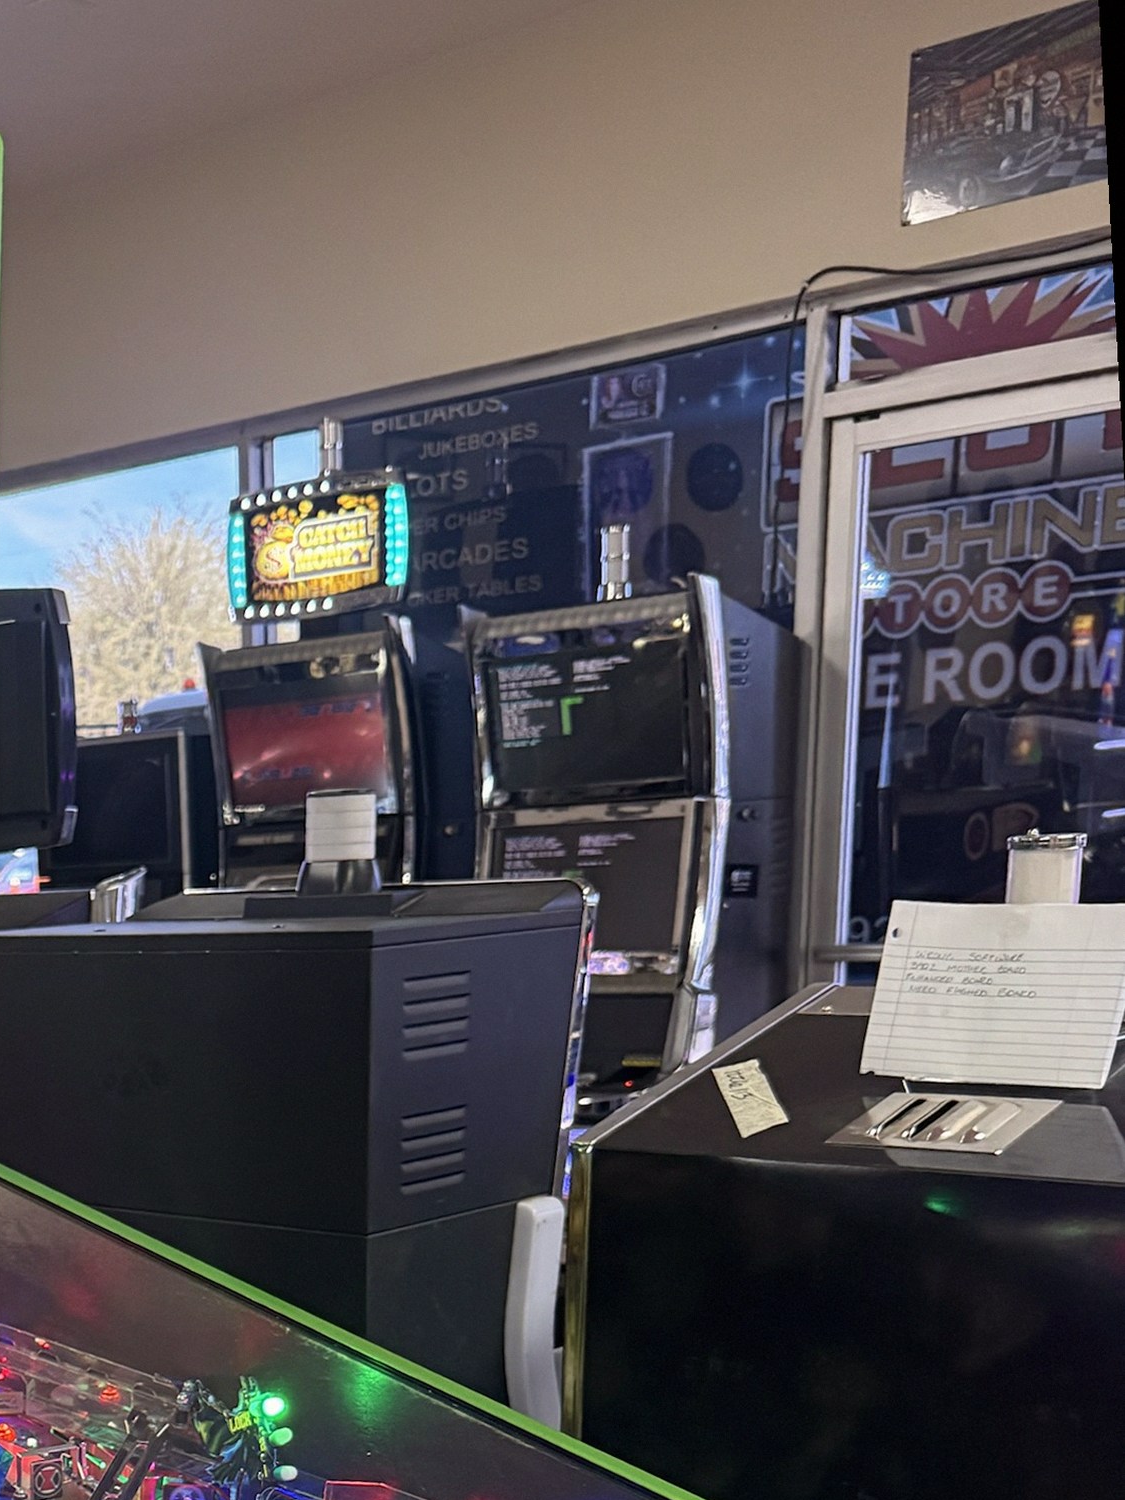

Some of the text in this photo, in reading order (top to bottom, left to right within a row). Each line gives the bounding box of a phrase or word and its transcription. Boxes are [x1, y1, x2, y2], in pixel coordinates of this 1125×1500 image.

[371, 397, 502, 435] BILLIARDS
[419, 421, 539, 460] JUKEBOXES
[298, 518, 368, 548] CATCH
[444, 505, 507, 531] CHIPS
[293, 540, 373, 574] MONEY
[465, 574, 544, 600] TABLES
[923, 635, 1123, 704] ROOM
